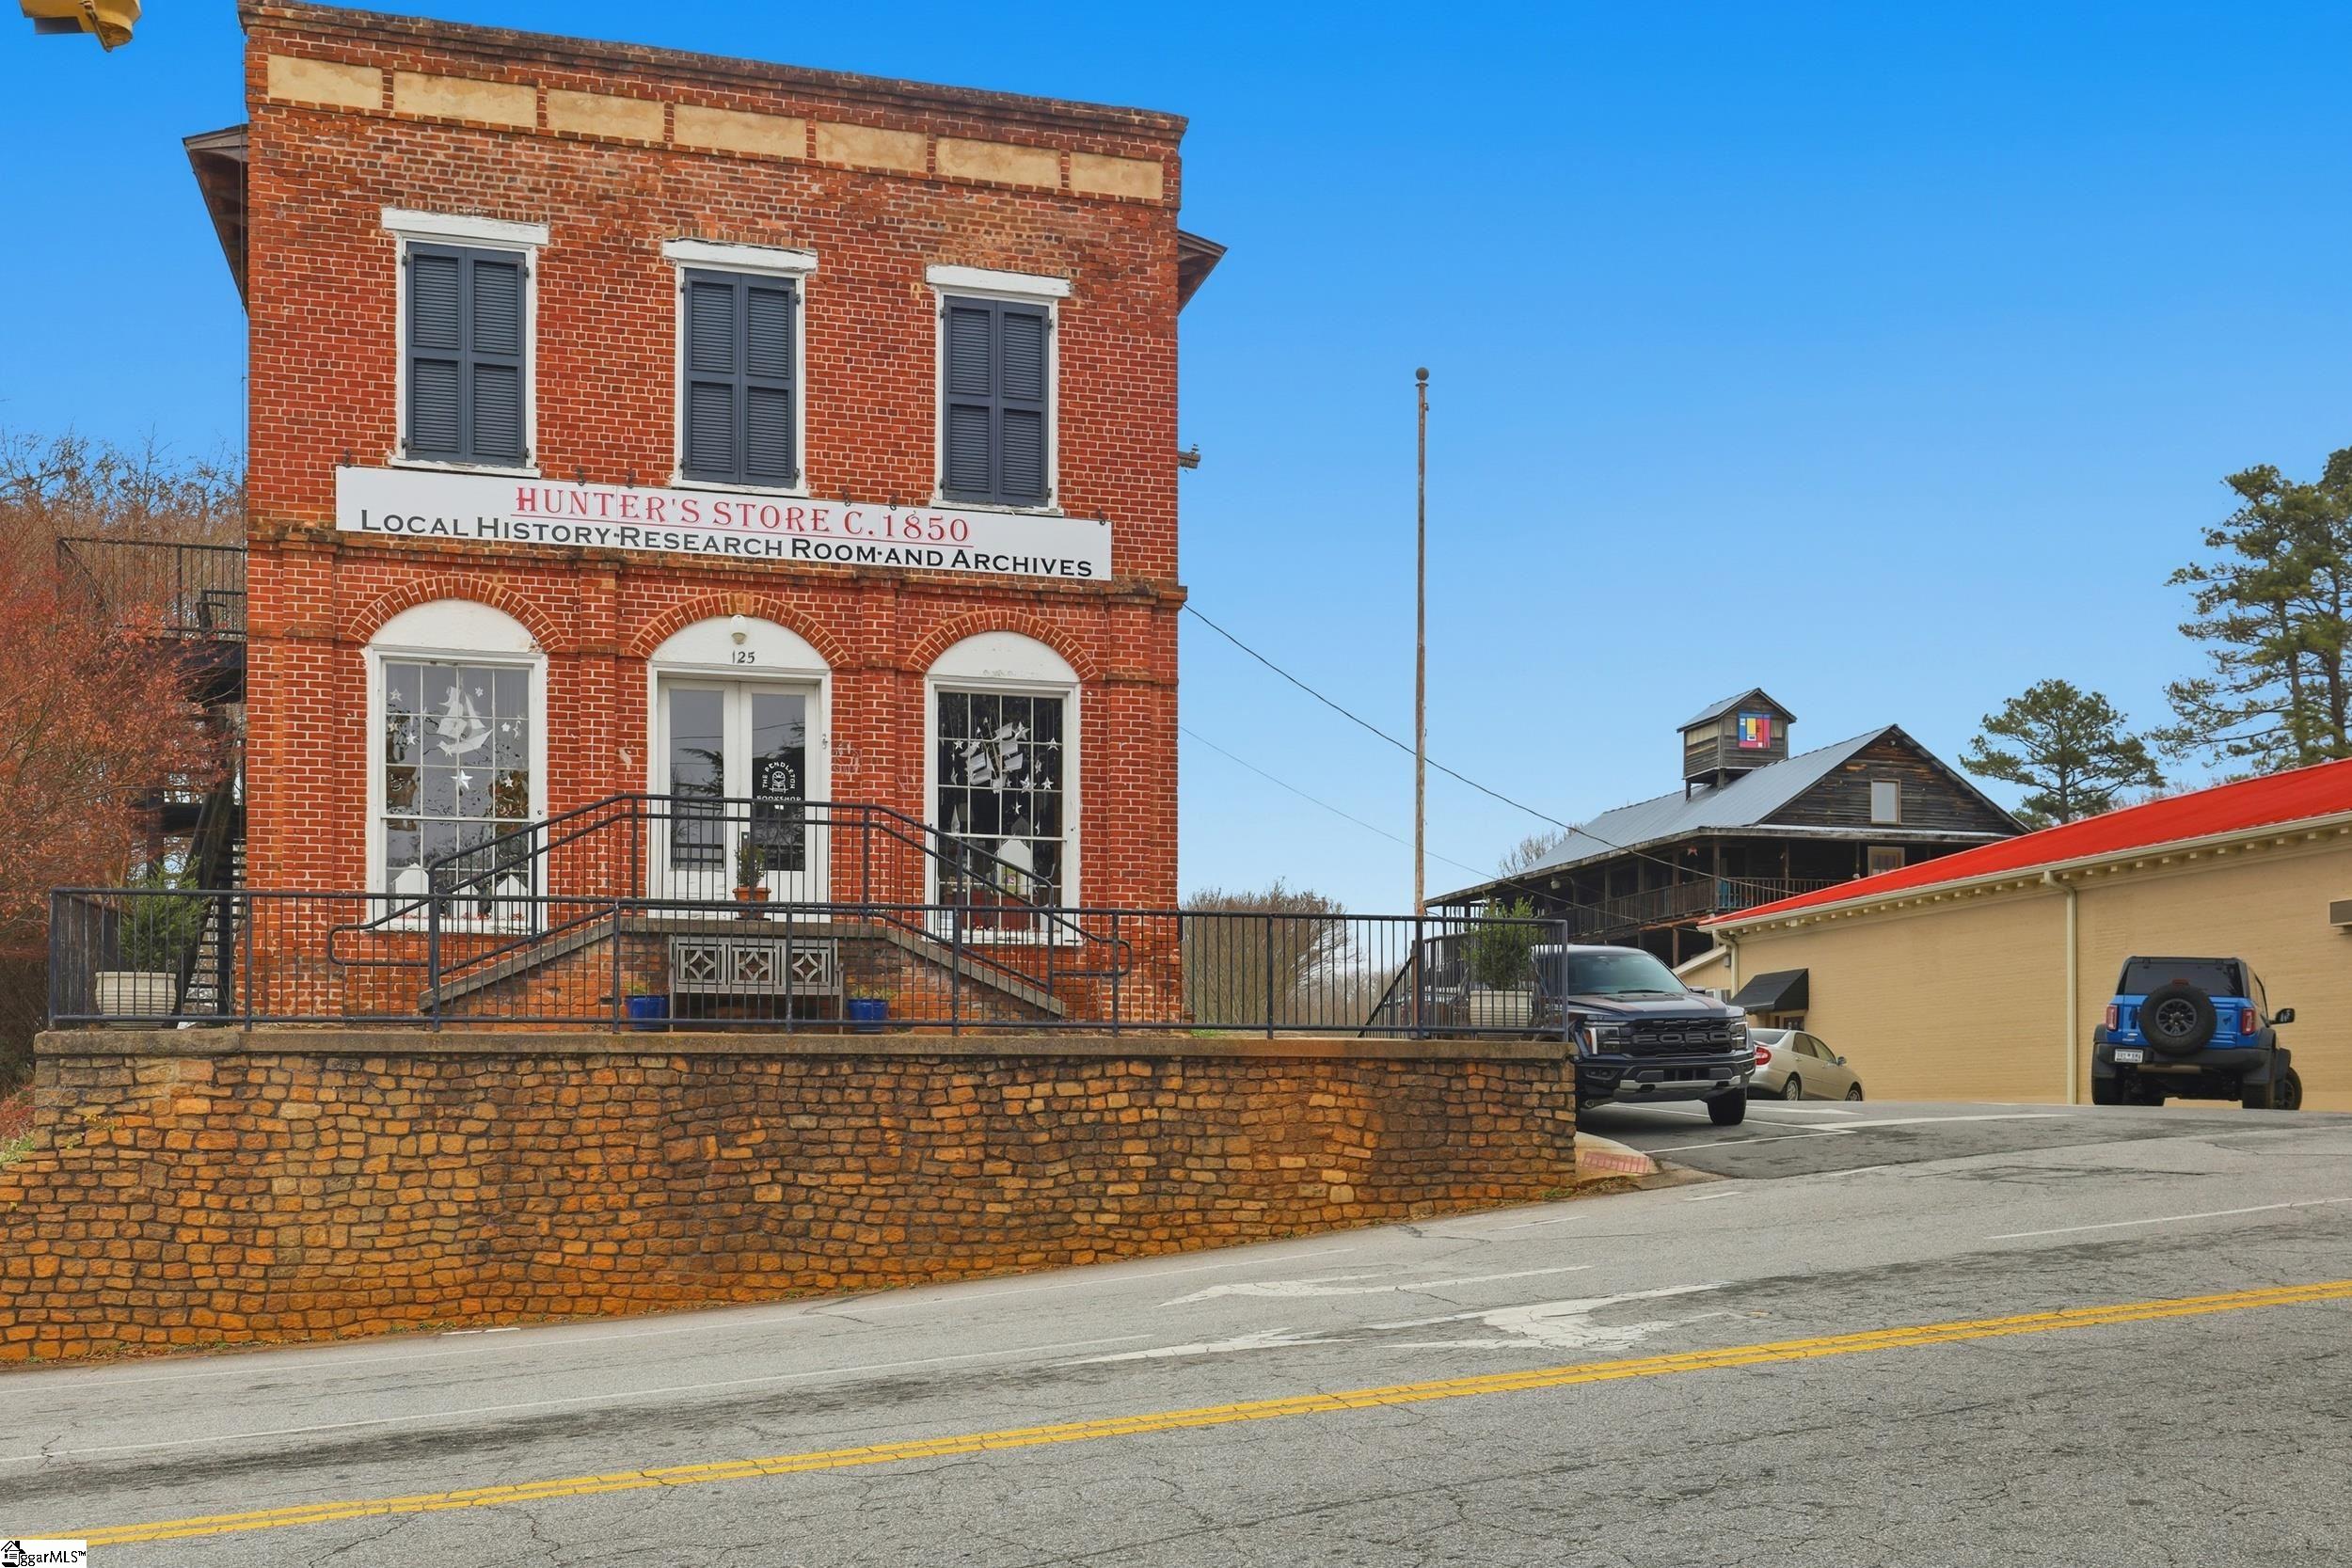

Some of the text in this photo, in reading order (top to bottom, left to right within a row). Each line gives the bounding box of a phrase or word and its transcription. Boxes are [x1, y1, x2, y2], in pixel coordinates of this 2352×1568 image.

[516, 487, 700, 525] HUNTER'S
[712, 500, 830, 533] STORE
[360, 509, 1092, 578] LOCAL HISTORY RESEARCH ROOM AND ARCHIVES
[732, 650, 755, 664] 125
[1631, 1029, 1731, 1046] FORD
